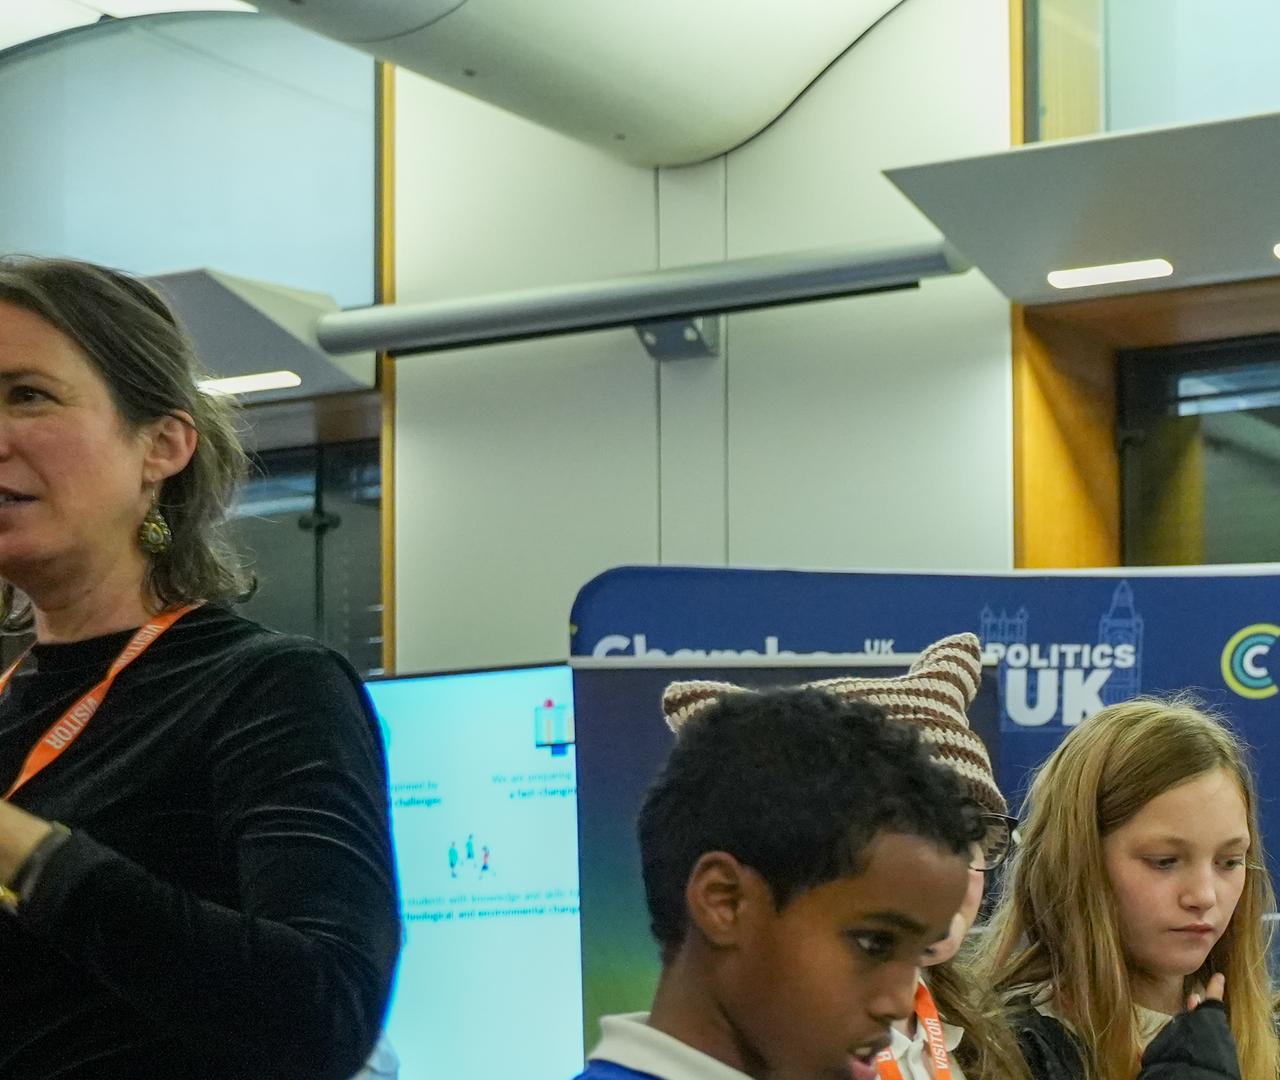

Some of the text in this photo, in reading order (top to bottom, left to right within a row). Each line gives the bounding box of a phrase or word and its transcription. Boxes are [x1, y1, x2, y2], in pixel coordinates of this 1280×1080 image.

[991, 642, 1136, 669] POLITICS
[1005, 668, 1114, 727] UK
[924, 1017, 949, 1070] VISITOR
